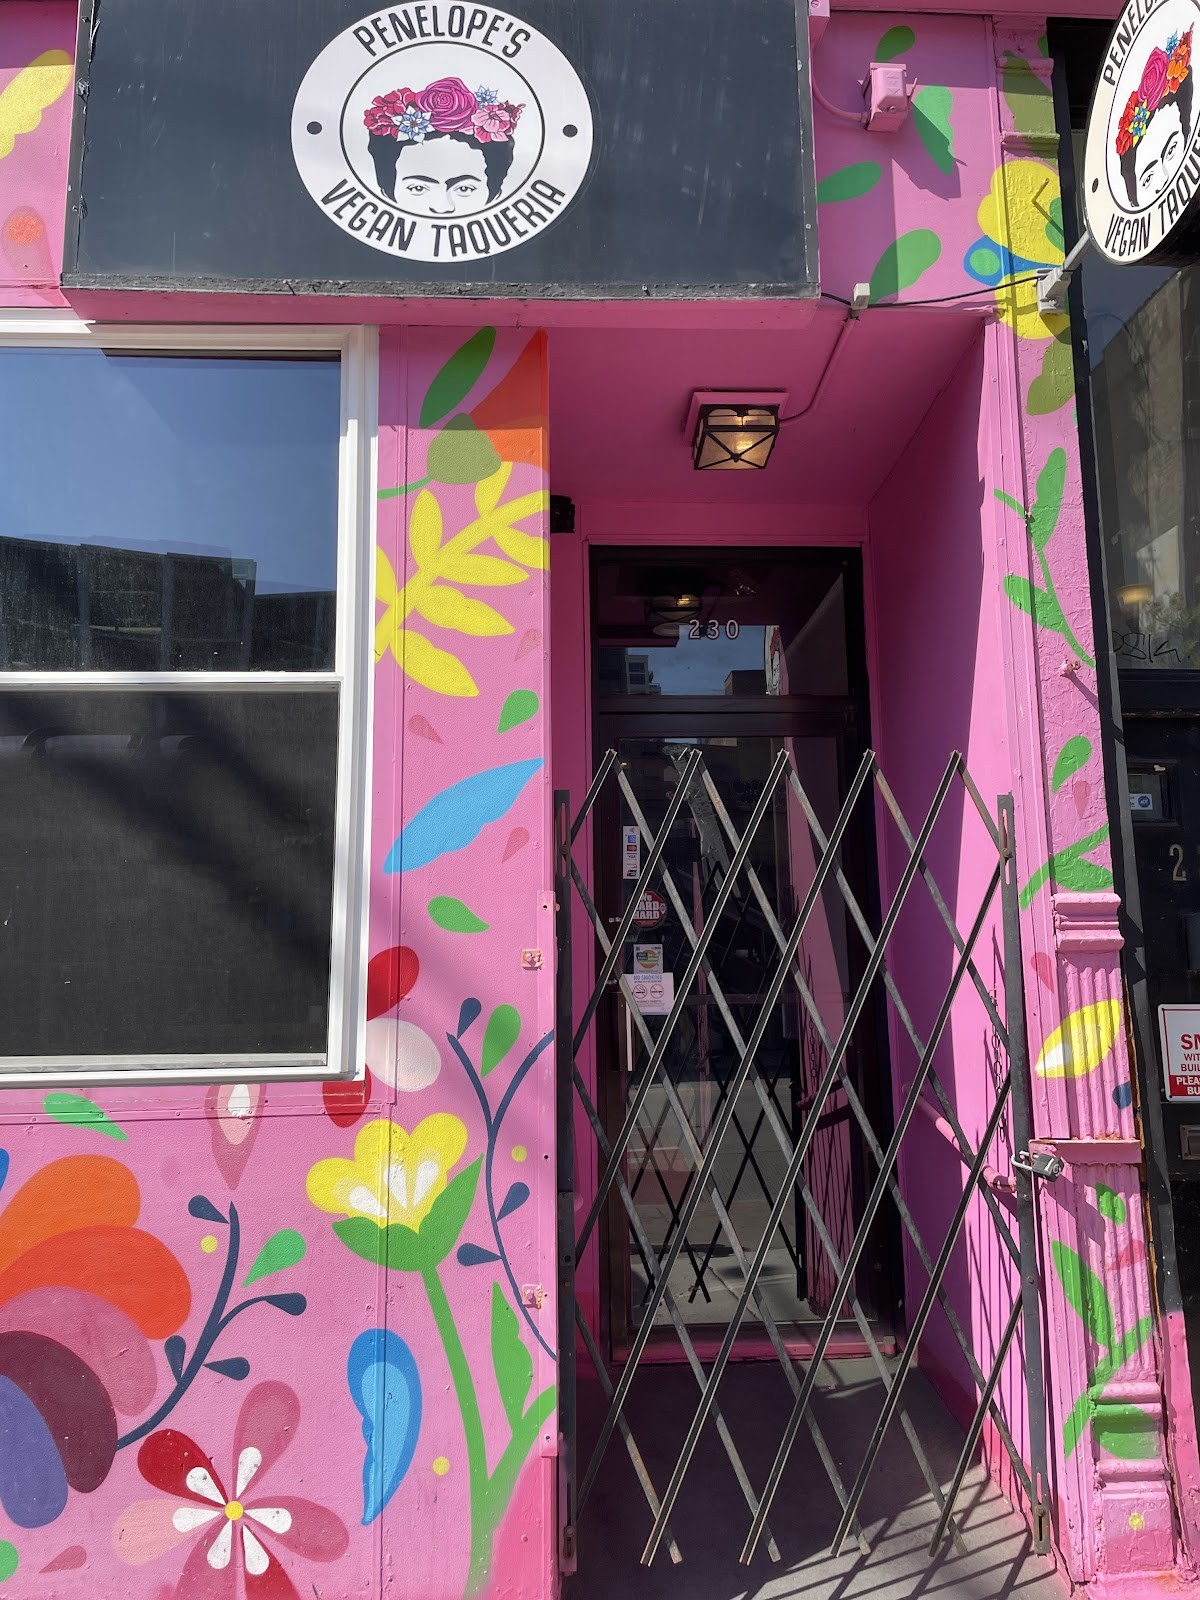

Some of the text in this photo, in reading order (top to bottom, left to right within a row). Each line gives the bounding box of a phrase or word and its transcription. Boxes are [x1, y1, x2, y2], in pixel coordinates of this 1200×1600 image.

[352, 5, 531, 58] PENELOPE'S
[321, 178, 566, 257] VEGAN TAQUERIA
[1104, 212, 1151, 257] VEGAN
[688, 619, 740, 639] 230
[1176, 1076, 1200, 1086] PLEA
